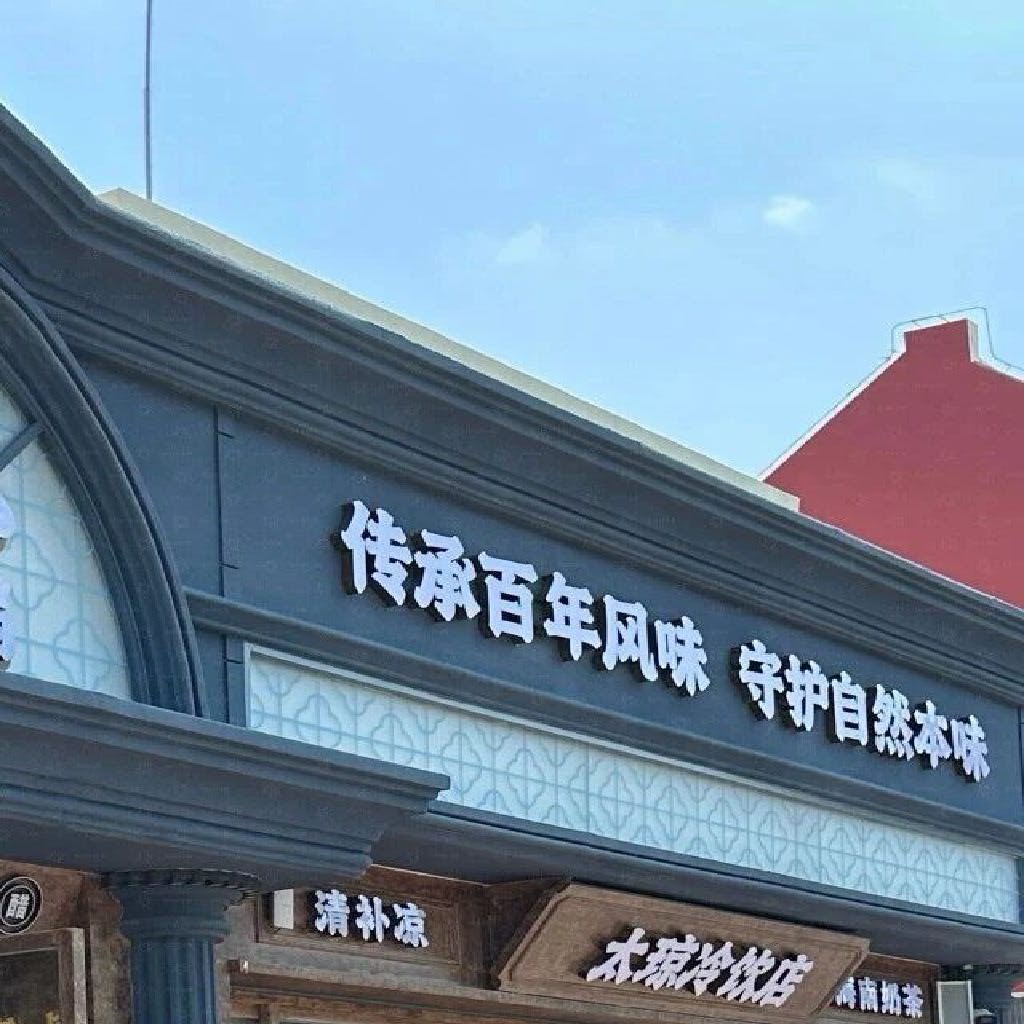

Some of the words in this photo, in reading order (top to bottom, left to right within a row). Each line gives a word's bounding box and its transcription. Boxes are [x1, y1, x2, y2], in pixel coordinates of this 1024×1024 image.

[341, 500, 711, 697] 传承百年风味
[737, 639, 992, 783] 守护自然本味
[313, 889, 430, 949] 清补凉
[585, 928, 815, 1008] 太琼冷饮店
